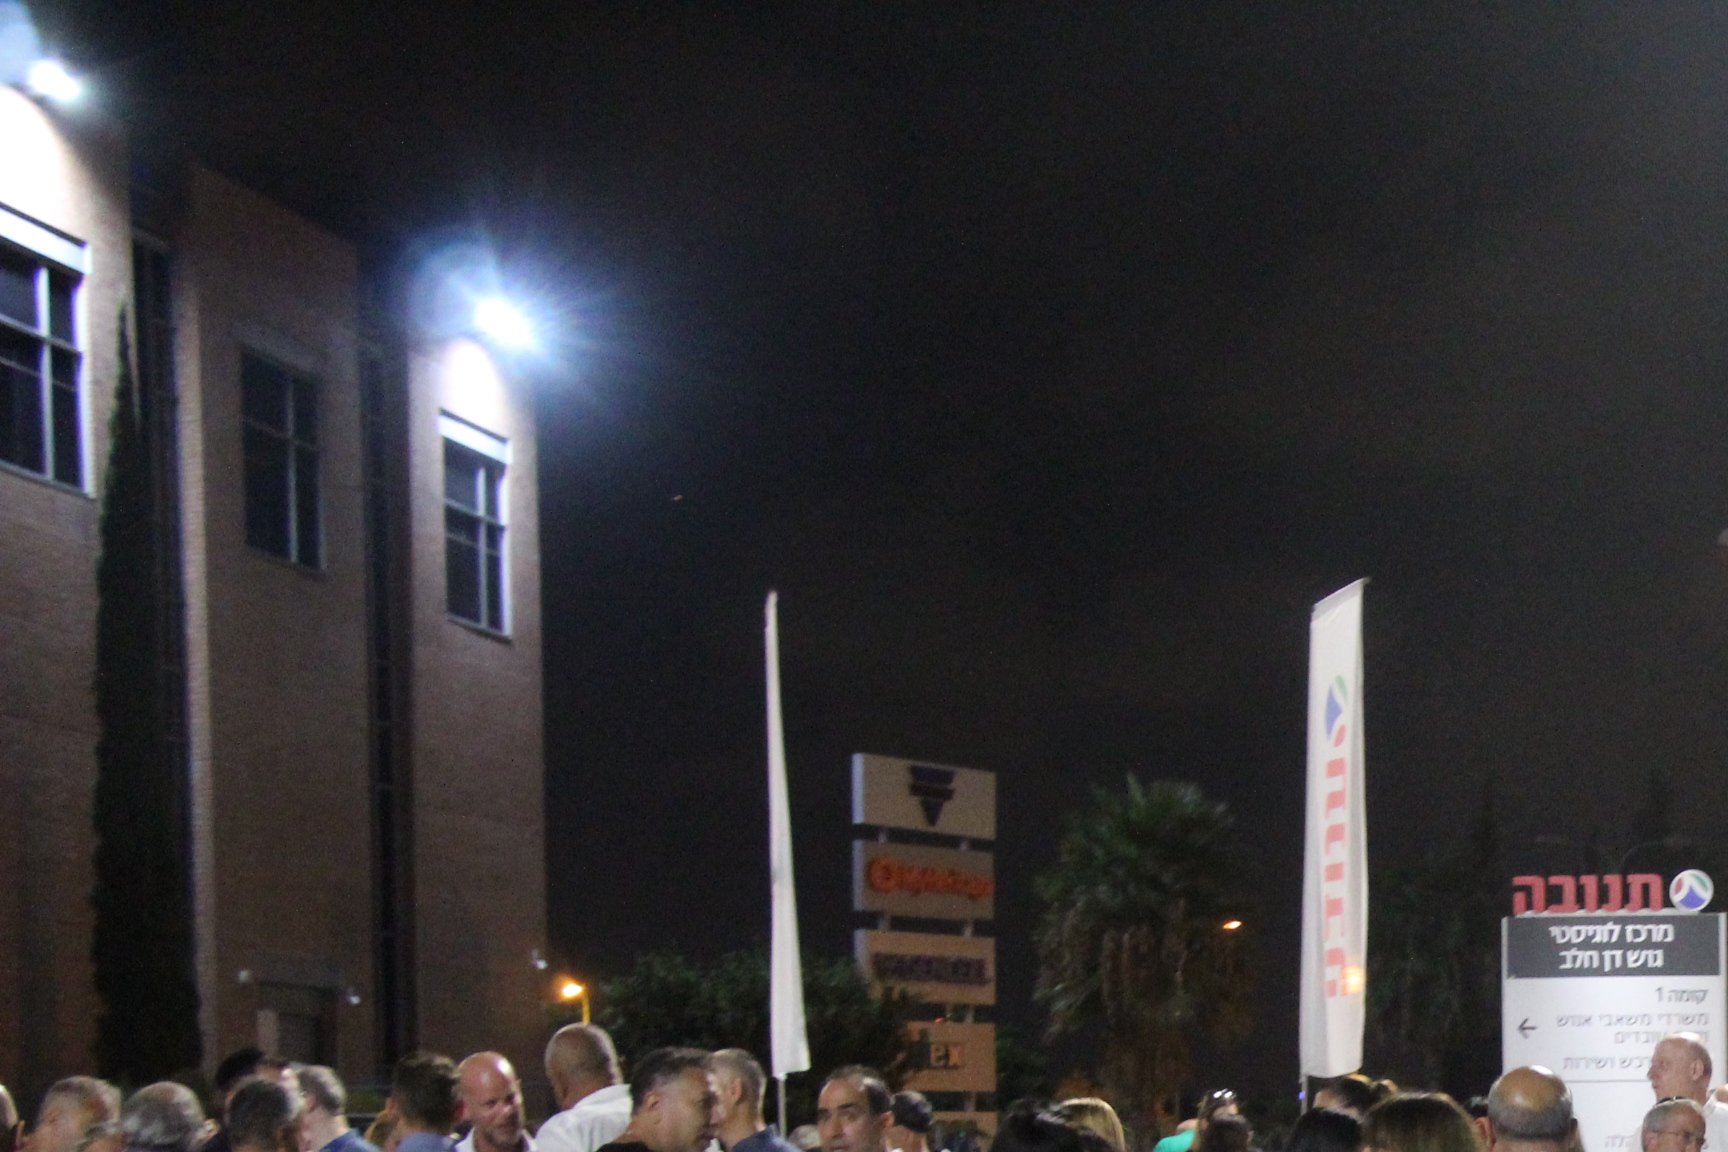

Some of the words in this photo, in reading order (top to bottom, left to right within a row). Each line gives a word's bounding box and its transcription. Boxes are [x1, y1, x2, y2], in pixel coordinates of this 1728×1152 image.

[1512, 873, 1664, 915] תנובה
[1549, 921, 1622, 944] לוגיסטי
[1625, 923, 1675, 943] מרכז
[1559, 947, 1600, 970] חלב
[1602, 949, 1623, 972] דן
[1626, 949, 1664, 968] גוש
[1655, 987, 1663, 1002] 1
[1667, 989, 1709, 1004] קומה
[1556, 1014, 1593, 1027] אנוש
[1599, 1013, 1652, 1027] משאבי
[1658, 1013, 1710, 1026] משרדי
